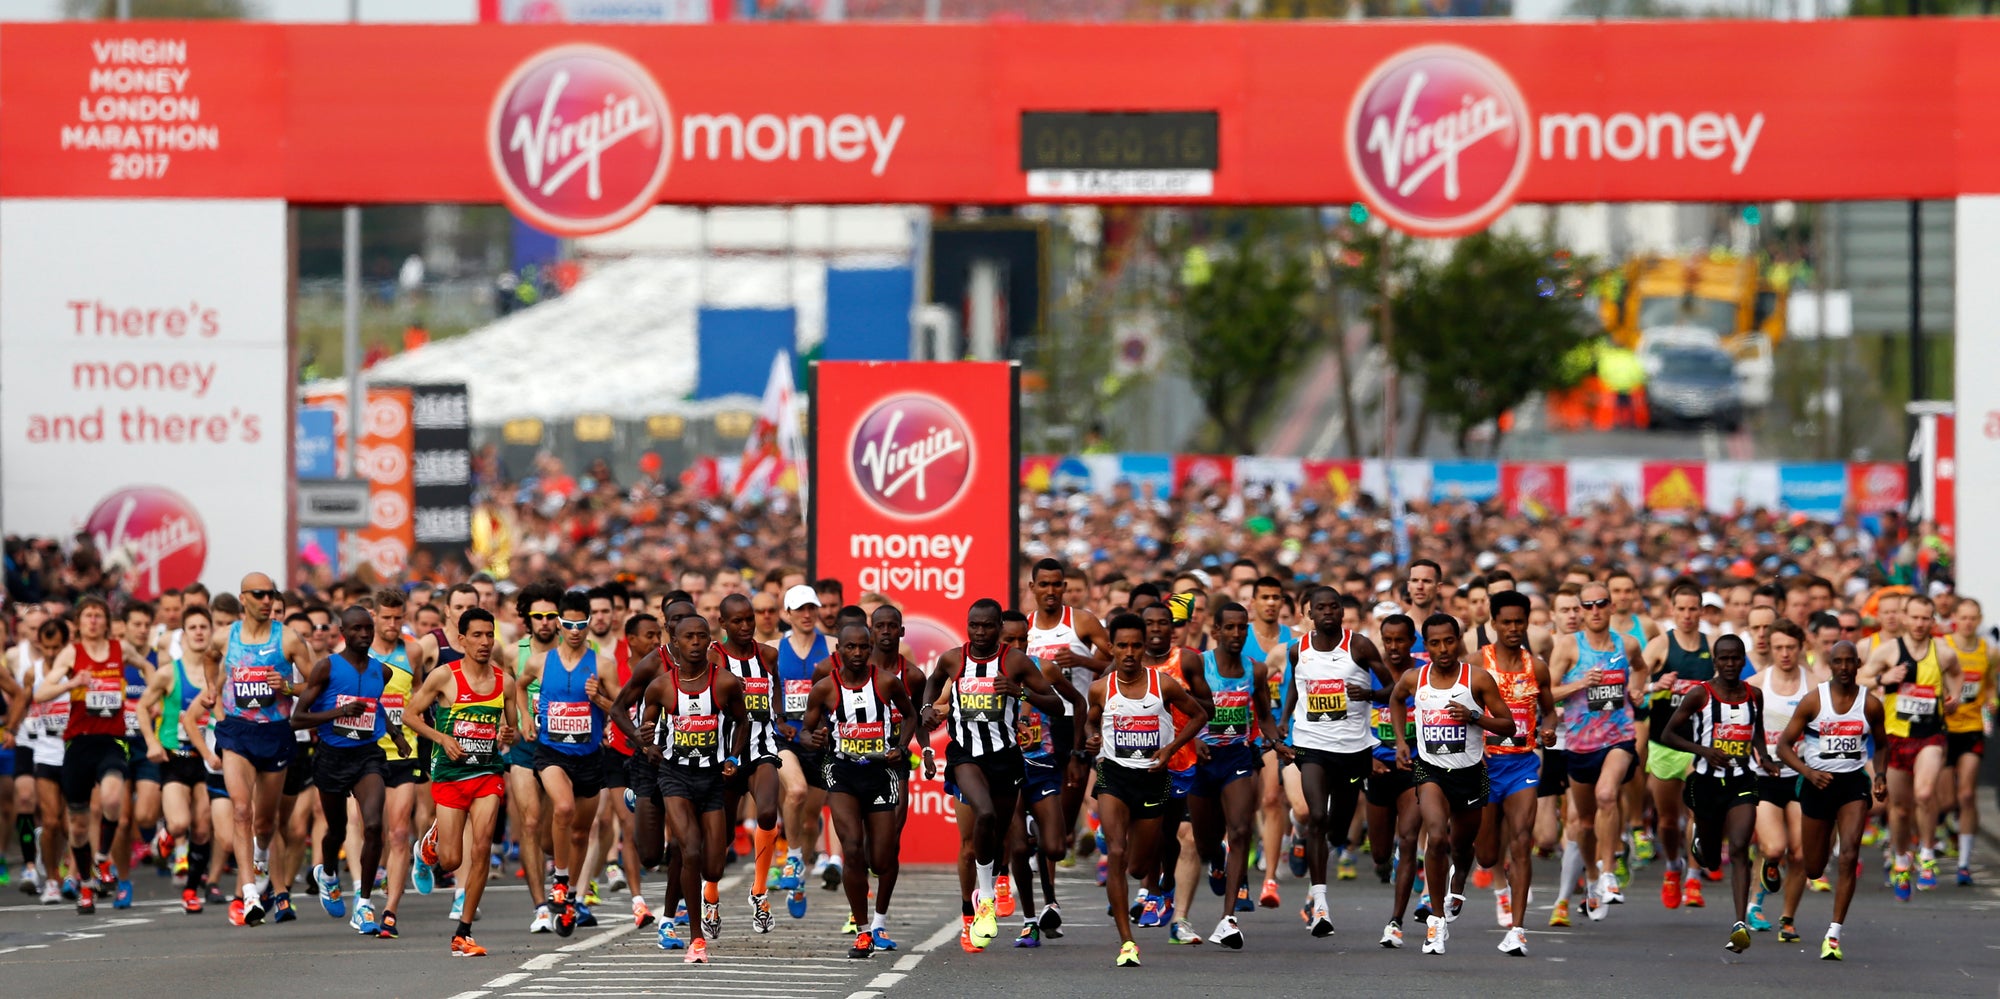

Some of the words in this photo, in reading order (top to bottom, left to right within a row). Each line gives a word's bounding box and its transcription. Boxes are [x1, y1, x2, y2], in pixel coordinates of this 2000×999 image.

[92, 39, 187, 64] VIRGIN
[90, 68, 189, 93] MONEY
[79, 96, 199, 121] LONDON
[61, 125, 219, 150] MARATHON
[509, 71, 652, 200] Virgin
[682, 114, 904, 176] money
[1366, 71, 1513, 200] Virgin
[1539, 113, 1765, 175] money
[109, 154, 169, 180] 2017
[67, 300, 220, 338] There's
[72, 360, 216, 398] money
[26, 408, 103, 443] and
[120, 407, 261, 443] there's
[861, 409, 964, 501] Virgin
[850, 533, 974, 567] money
[745, 694, 762, 710] CE
[762, 694, 769, 710] 9
[960, 694, 992, 710] PACE
[996, 694, 1003, 709] 1
[1308, 696, 1342, 711] KIRUI
[549, 717, 591, 732] GUERRA
[692, 718, 716, 727] money
[859, 725, 882, 734] money
[675, 731, 706, 747] PACE
[708, 731, 716, 745] 2
[1116, 730, 1160, 748] GHIRMAY
[1423, 726, 1466, 742] BEKELE
[841, 738, 872, 754] PACE
[876, 739, 884, 753] 8
[1713, 738, 1745, 757] PACE
[1826, 738, 1857, 753] 1268
